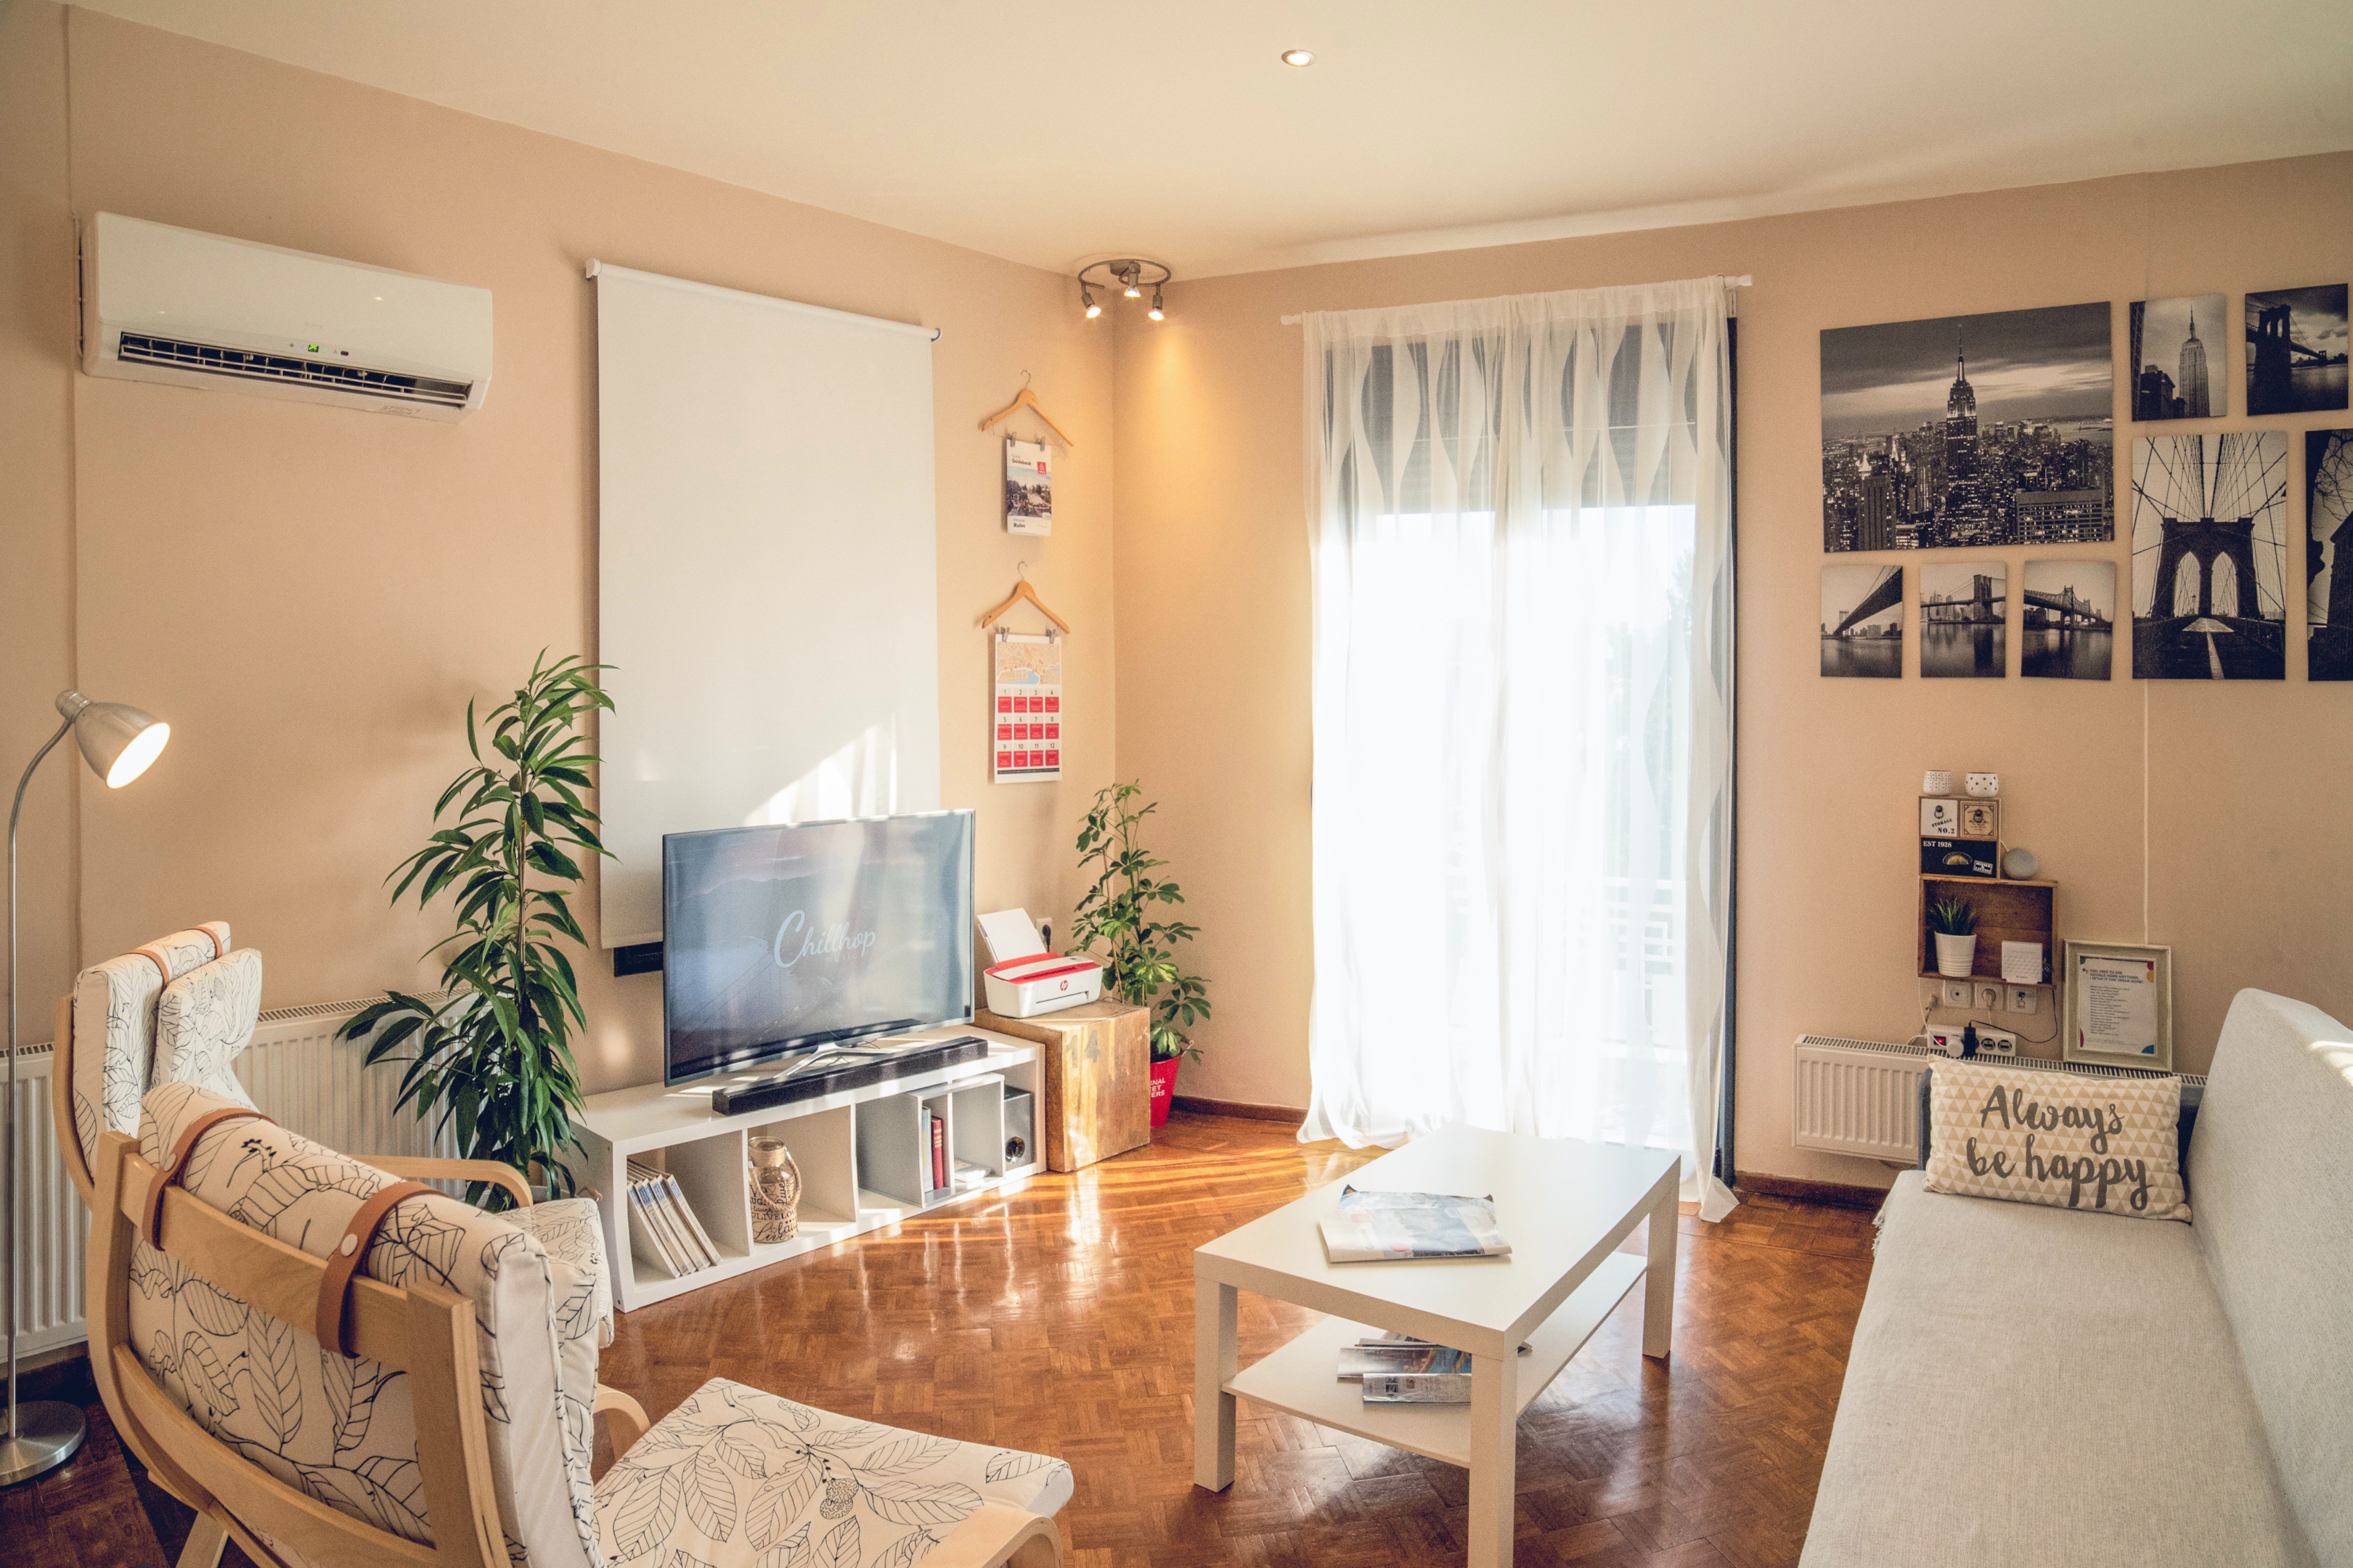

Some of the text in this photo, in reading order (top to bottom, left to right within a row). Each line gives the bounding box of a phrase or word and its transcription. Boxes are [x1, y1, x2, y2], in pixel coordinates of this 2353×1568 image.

[1932, 818, 1952, 828] STORAGE
[774, 910, 876, 968] Chillhop
[825, 952, 858, 964] music
[1980, 1085, 2125, 1155] Always
[1966, 1133, 2154, 1211] be happy
[752, 1221, 787, 1241] Live
